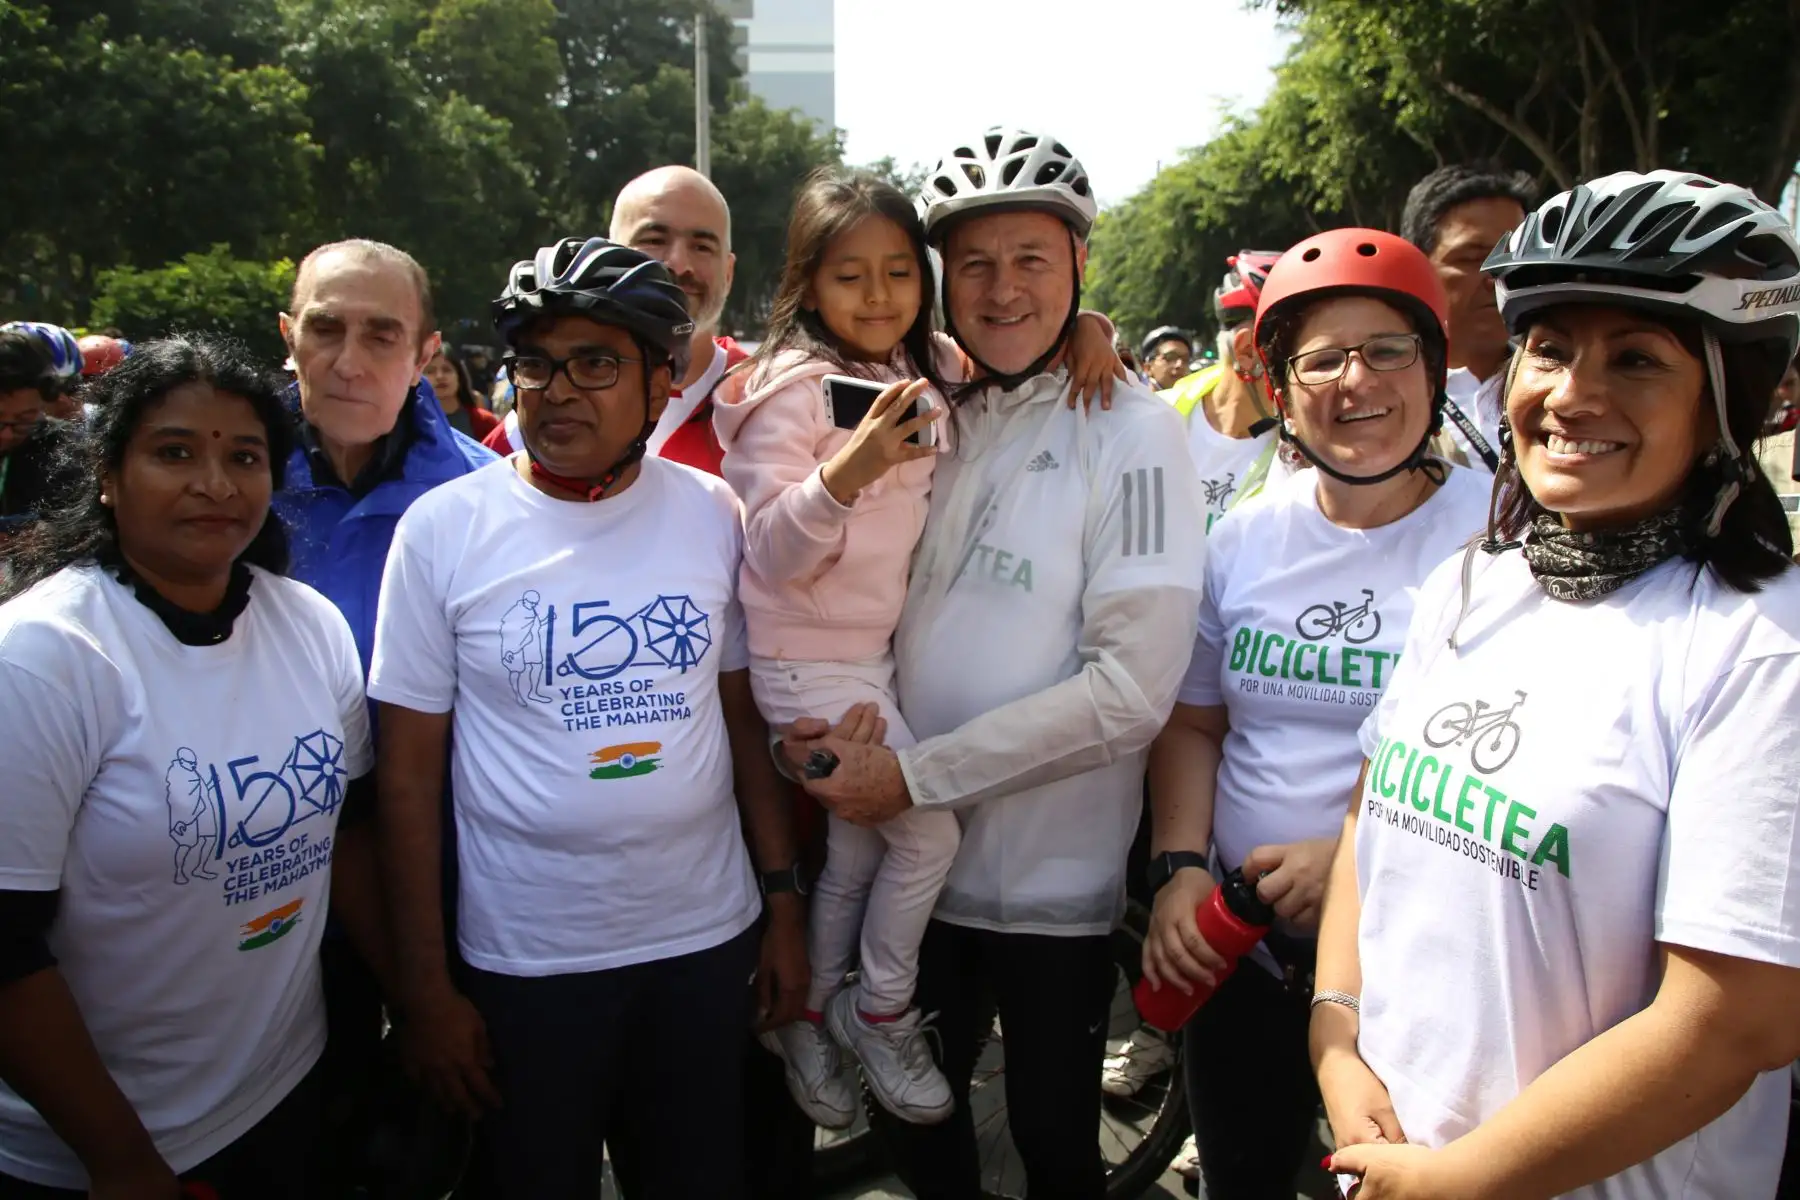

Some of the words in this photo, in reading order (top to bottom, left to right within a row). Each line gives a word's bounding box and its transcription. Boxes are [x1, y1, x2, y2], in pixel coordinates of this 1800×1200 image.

[1229, 627, 1401, 689] BICICLET
[559, 681, 625, 701] YEARS
[629, 679, 654, 693] OF
[561, 692, 685, 717] CELEBRATING
[1240, 678, 1259, 694] POR
[1263, 681, 1283, 697] UNA
[1287, 684, 1345, 704] MOVILIDAD
[1350, 692, 1382, 707] SOST
[563, 715, 602, 732] THE
[606, 706, 691, 727] MAHATMA
[1367, 736, 1570, 879] ICICLETEA
[223, 836, 331, 891] CELEBRATING
[226, 844, 286, 874] YEARS
[289, 833, 309, 853] OF
[1401, 813, 1460, 851] MOVILIDAD
[1462, 838, 1539, 891] SOSTENIBLE
[223, 886, 260, 907] THE
